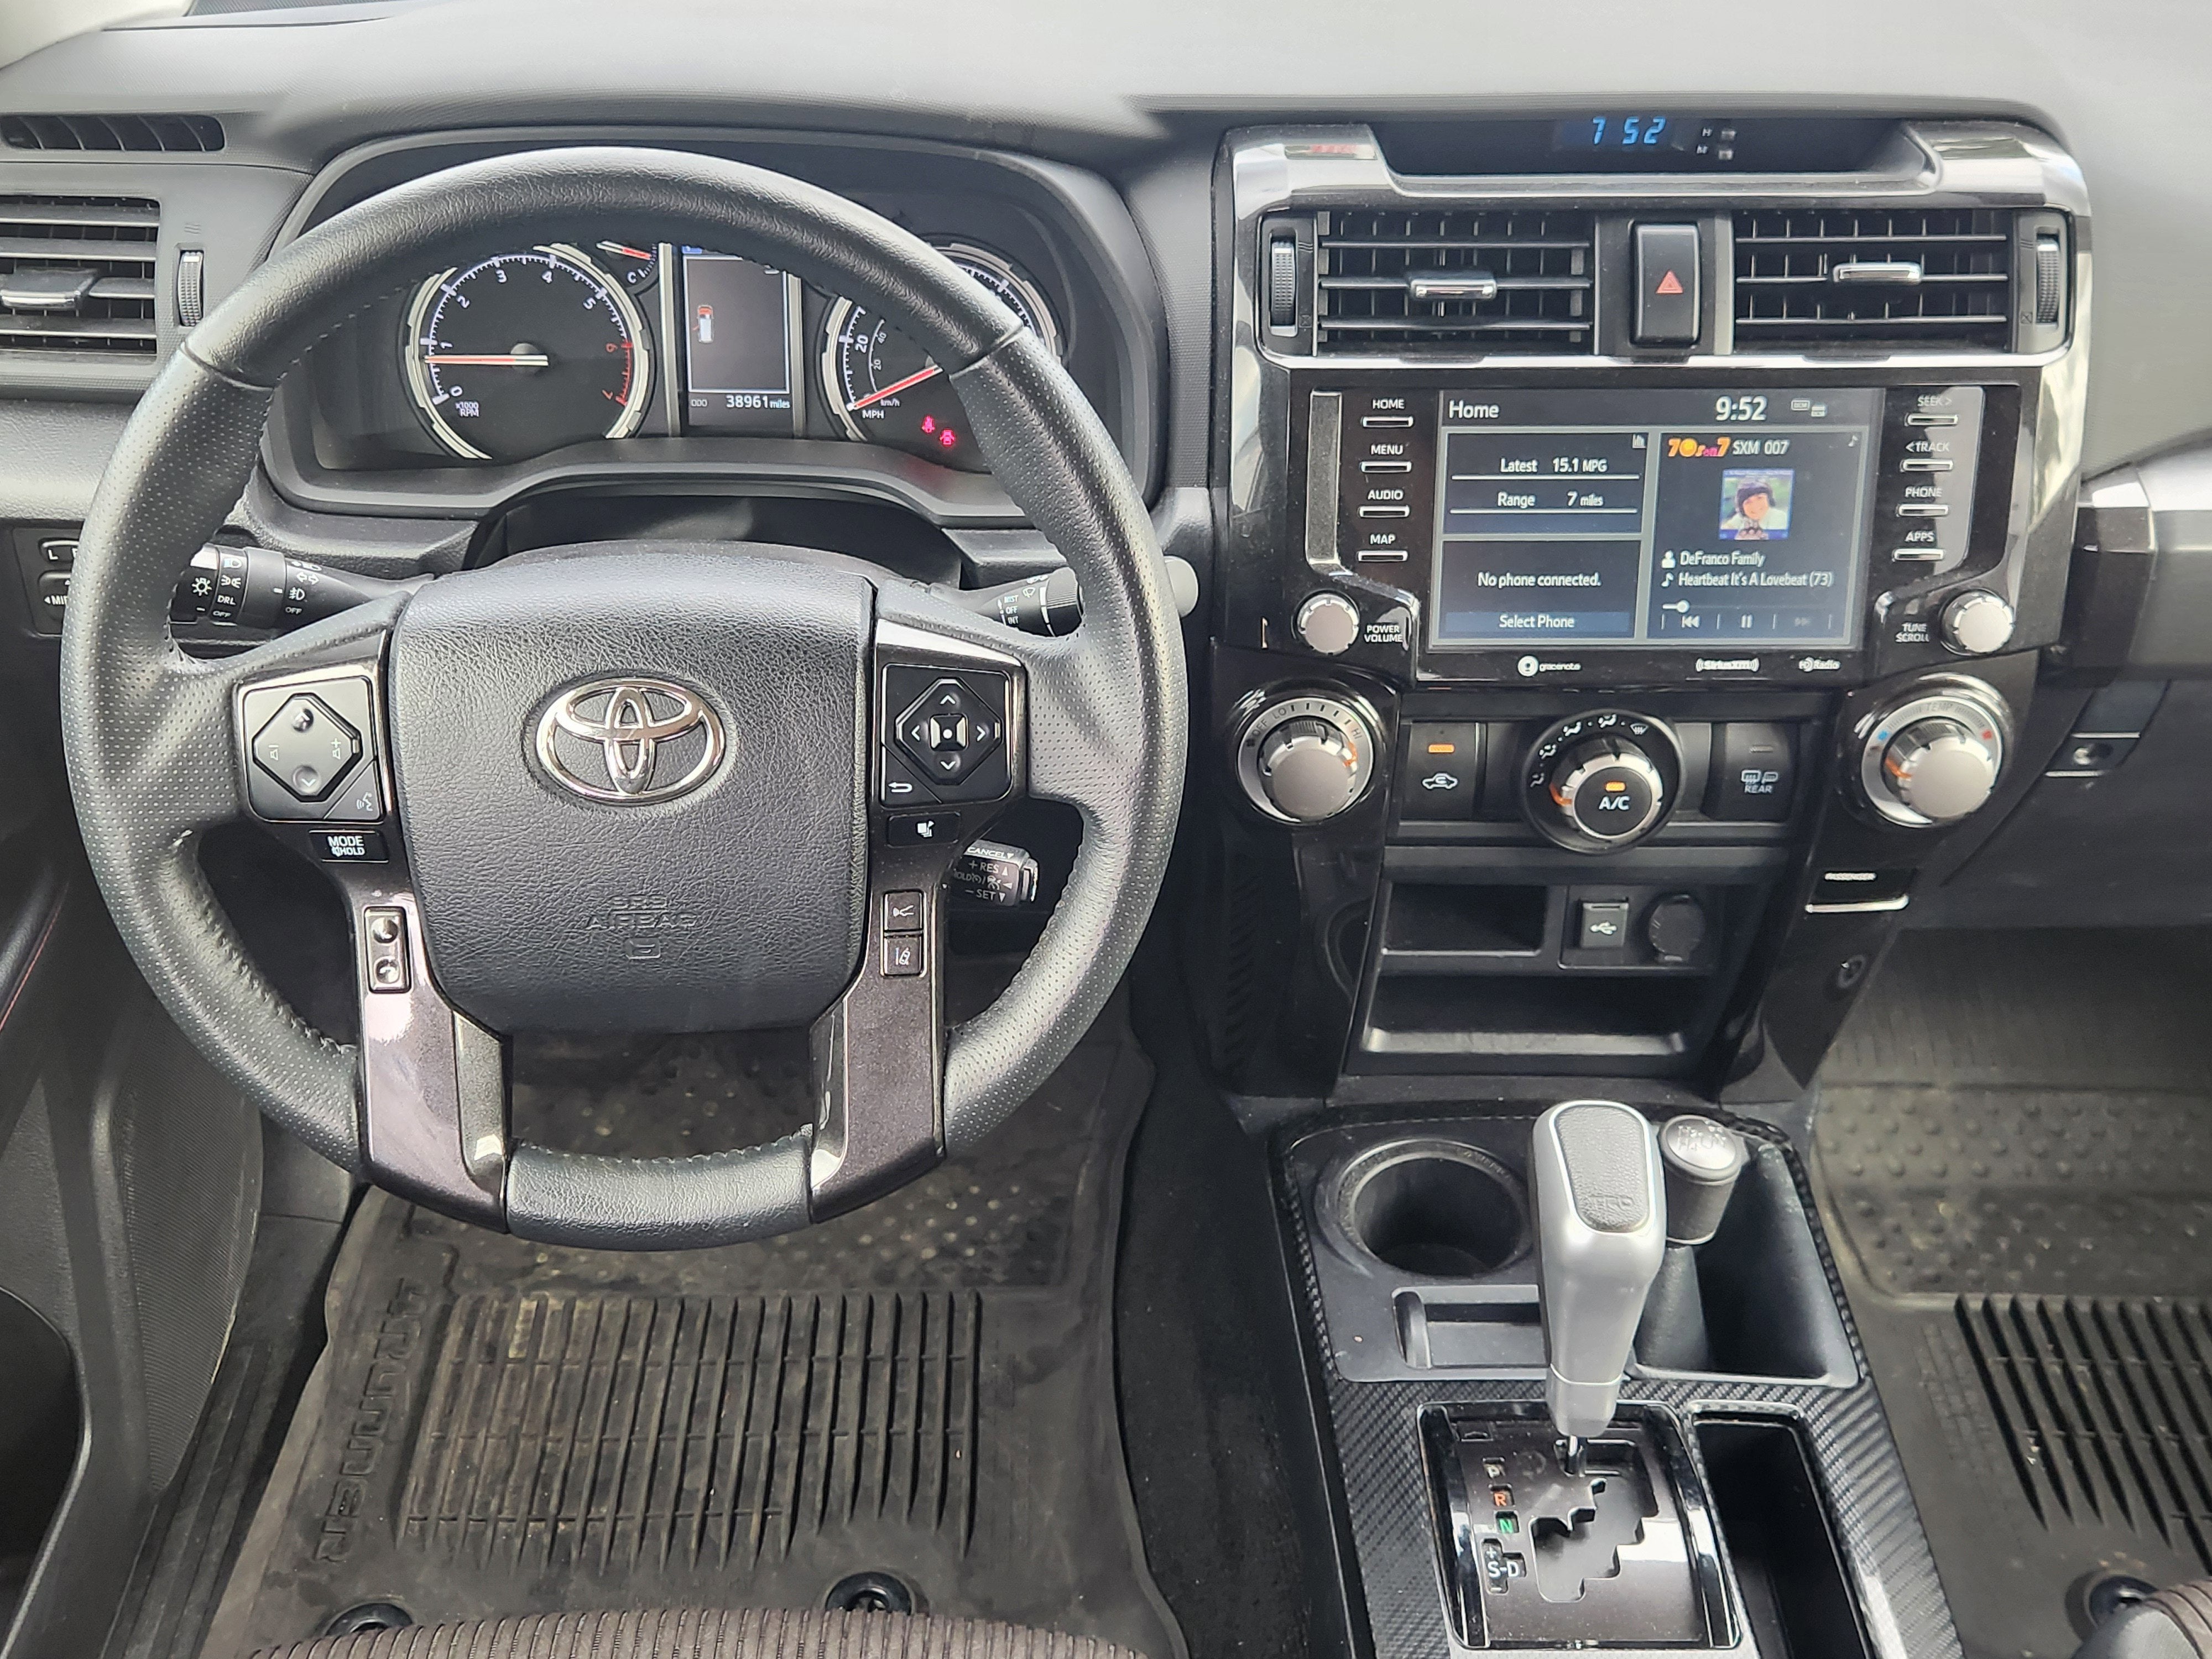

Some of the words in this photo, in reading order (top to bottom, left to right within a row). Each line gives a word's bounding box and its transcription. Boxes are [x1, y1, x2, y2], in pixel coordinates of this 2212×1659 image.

[1593, 117, 1605, 144] 7
[1623, 116, 1666, 144] 52
[1702, 128, 1712, 137] H
[497, 271, 507, 283] 3
[542, 271, 553, 284] 4
[628, 272, 637, 283] C
[458, 296, 470, 309] 2
[583, 298, 596, 310] 5
[855, 335, 869, 353] 20
[878, 332, 887, 344] 40
[873, 359, 882, 371] 20
[450, 385, 463, 397] 0
[691, 399, 707, 407] ODO
[726, 395, 768, 409] 38961
[770, 398, 790, 409] miles
[1373, 398, 1405, 410] HOME
[1715, 395, 1767, 421] 9:52
[460, 409, 479, 418] RPM
[862, 409, 885, 419] MPH
[1448, 400, 1500, 419] Home
[1370, 445, 1404, 455] MENU
[1732, 440, 1760, 455] SXM
[1764, 440, 1791, 455] 007
[1500, 457, 1537, 473] Latest
[1552, 457, 1580, 472] 15.1
[1582, 458, 1608, 472] MPG
[1368, 489, 1404, 500] AUDIO
[1905, 487, 1943, 498] PHONE
[1498, 492, 1536, 508] Range
[1567, 492, 1578, 506] 7
[1580, 493, 1604, 507] miles
[1370, 534, 1396, 545] MAP
[1905, 531, 1934, 542] APPS
[1679, 552, 1730, 566] DeFranco
[1731, 552, 1765, 567] Family
[1478, 572, 1496, 587] No
[1498, 572, 1536, 589] phone
[1537, 572, 1601, 588] connected.
[1678, 572, 1729, 587] Heartbeat
[1730, 573, 1747, 586] It's
[1749, 574, 1758, 586] A
[1760, 573, 1807, 587] Lovebeat
[1809, 572, 1833, 587] (73)
[217, 594, 236, 606] DRL
[285, 606, 302, 614] OFF
[1499, 614, 1536, 628] Select
[1537, 614, 1575, 628] Phone
[1366, 625, 1400, 634] POWER
[1902, 623, 1927, 633] TUNE
[1364, 634, 1403, 643] VOLUME
[1896, 633, 1930, 643] SCROLL
[1272, 707, 1287, 719] LO
[1251, 718, 1268, 737] OFF
[1744, 785, 1773, 794] REAR
[1599, 796, 1630, 811] A/C
[327, 835, 364, 848] MODE
[340, 847, 365, 856] HOLD
[967, 847, 1006, 859] CANCEL
[1487, 1465, 1500, 1479] P
[1493, 1493, 1507, 1507] R
[1499, 1518, 1514, 1534] N
